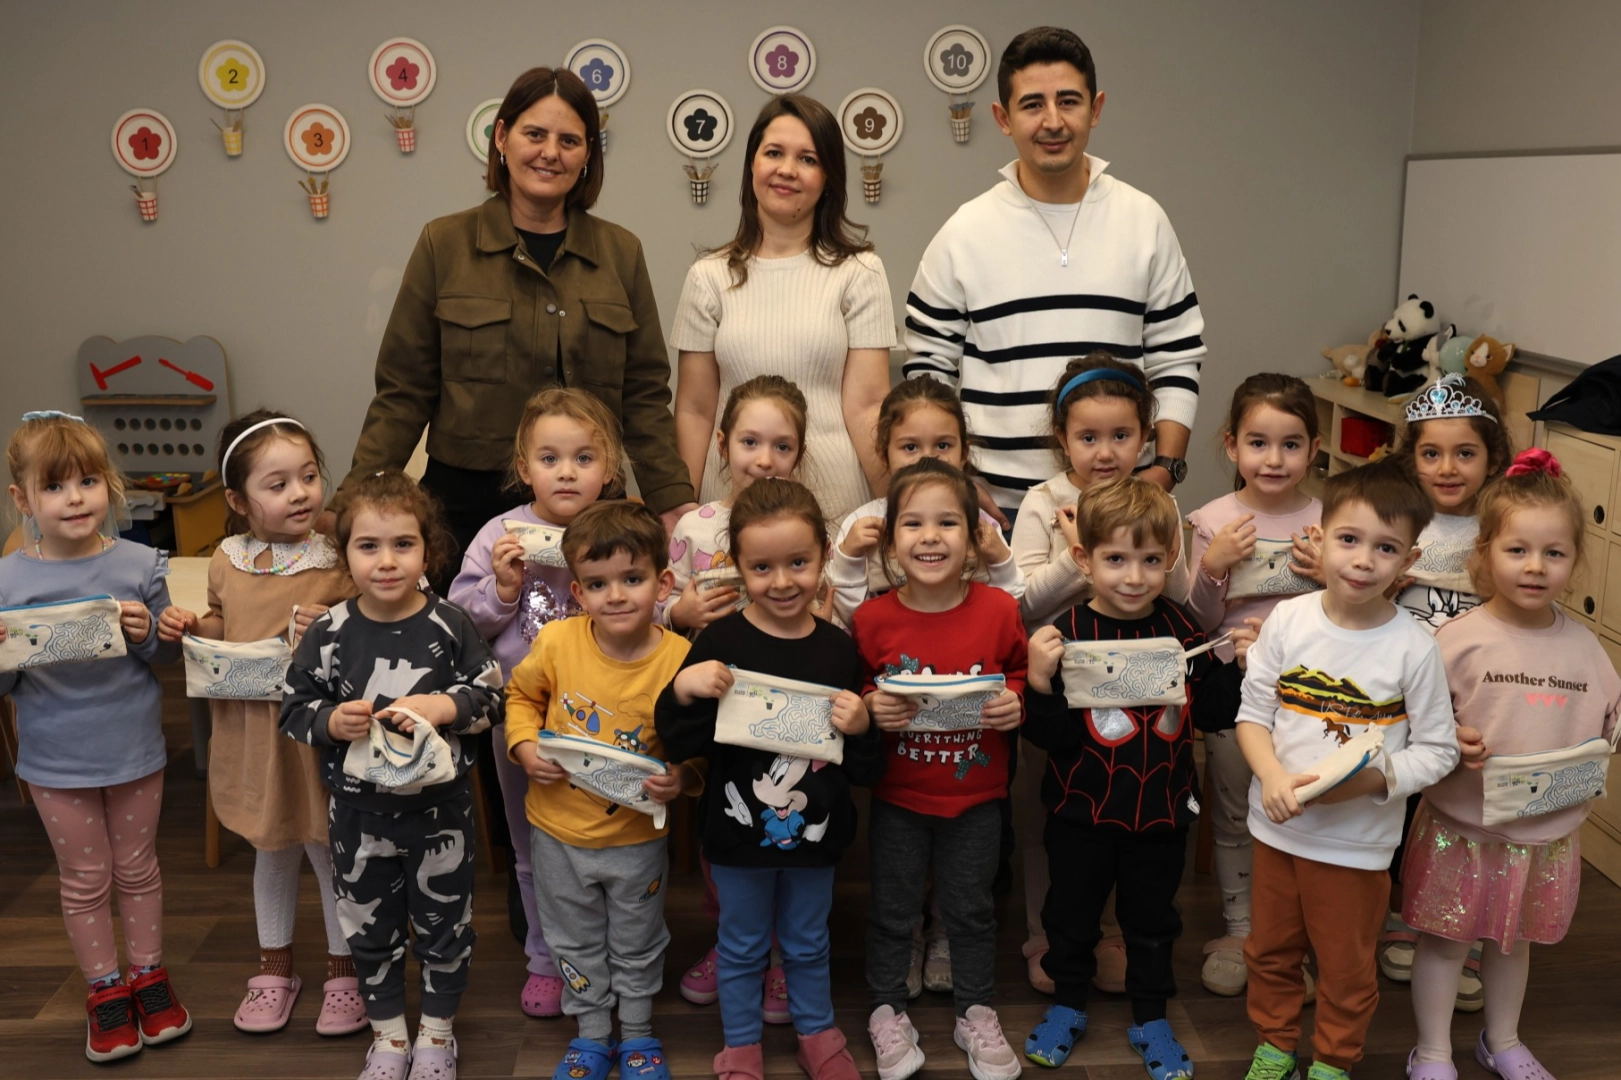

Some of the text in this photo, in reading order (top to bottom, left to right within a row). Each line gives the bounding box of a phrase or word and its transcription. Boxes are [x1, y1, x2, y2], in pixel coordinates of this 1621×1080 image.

[777, 55, 787, 70] 8
[948, 54, 968, 70] 10
[228, 69, 239, 84] 2
[398, 68, 408, 82] 4
[592, 69, 602, 84] 6
[696, 120, 706, 134] 7
[865, 118, 875, 133] 9
[141, 138, 149, 151] 1
[314, 132, 324, 147] 3
[1482, 671, 1588, 692] Another Sunset
[897, 741, 979, 763] BETTER
